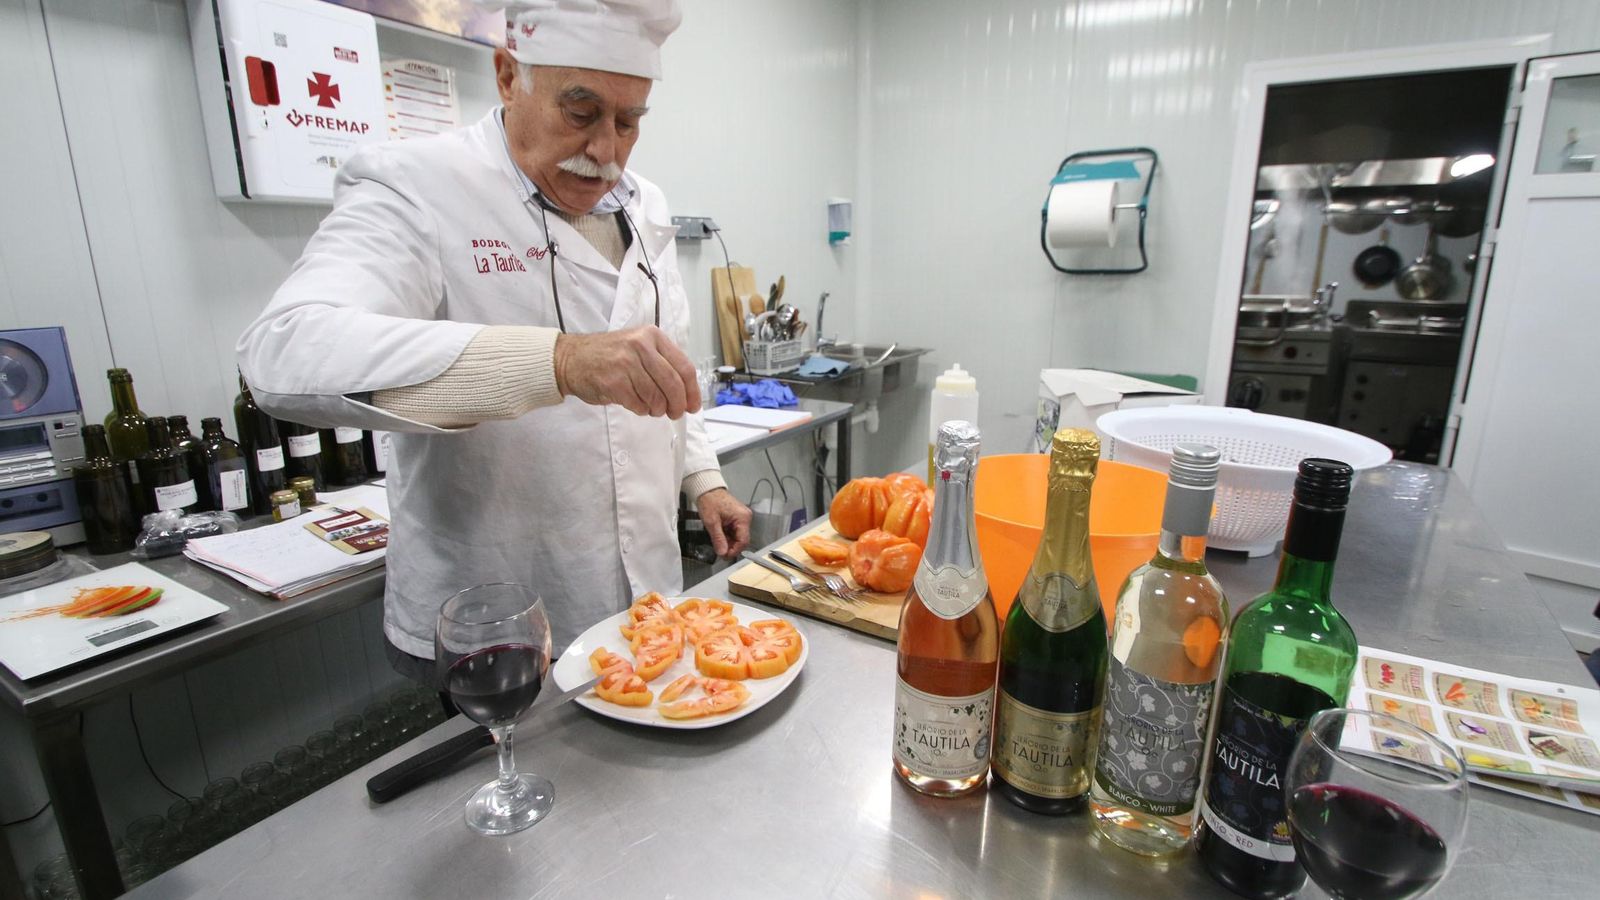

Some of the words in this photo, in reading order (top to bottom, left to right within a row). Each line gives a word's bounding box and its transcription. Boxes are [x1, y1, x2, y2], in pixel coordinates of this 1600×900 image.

[305, 114, 370, 134] FREMAP
[474, 254, 491, 273] La
[526, 247, 549, 260] Chef
[912, 729, 970, 750] TAUTILA
[1117, 719, 1187, 752] TAUTILA
[1012, 740, 1073, 768] TAUTILA
[1215, 738, 1281, 790] TAUTILA
[1252, 755, 1264, 768] DE
[1266, 760, 1278, 771] LA
[1108, 785, 1140, 807] BLANCO
[1149, 803, 1177, 813] WHITE
[1235, 834, 1254, 849] RED
